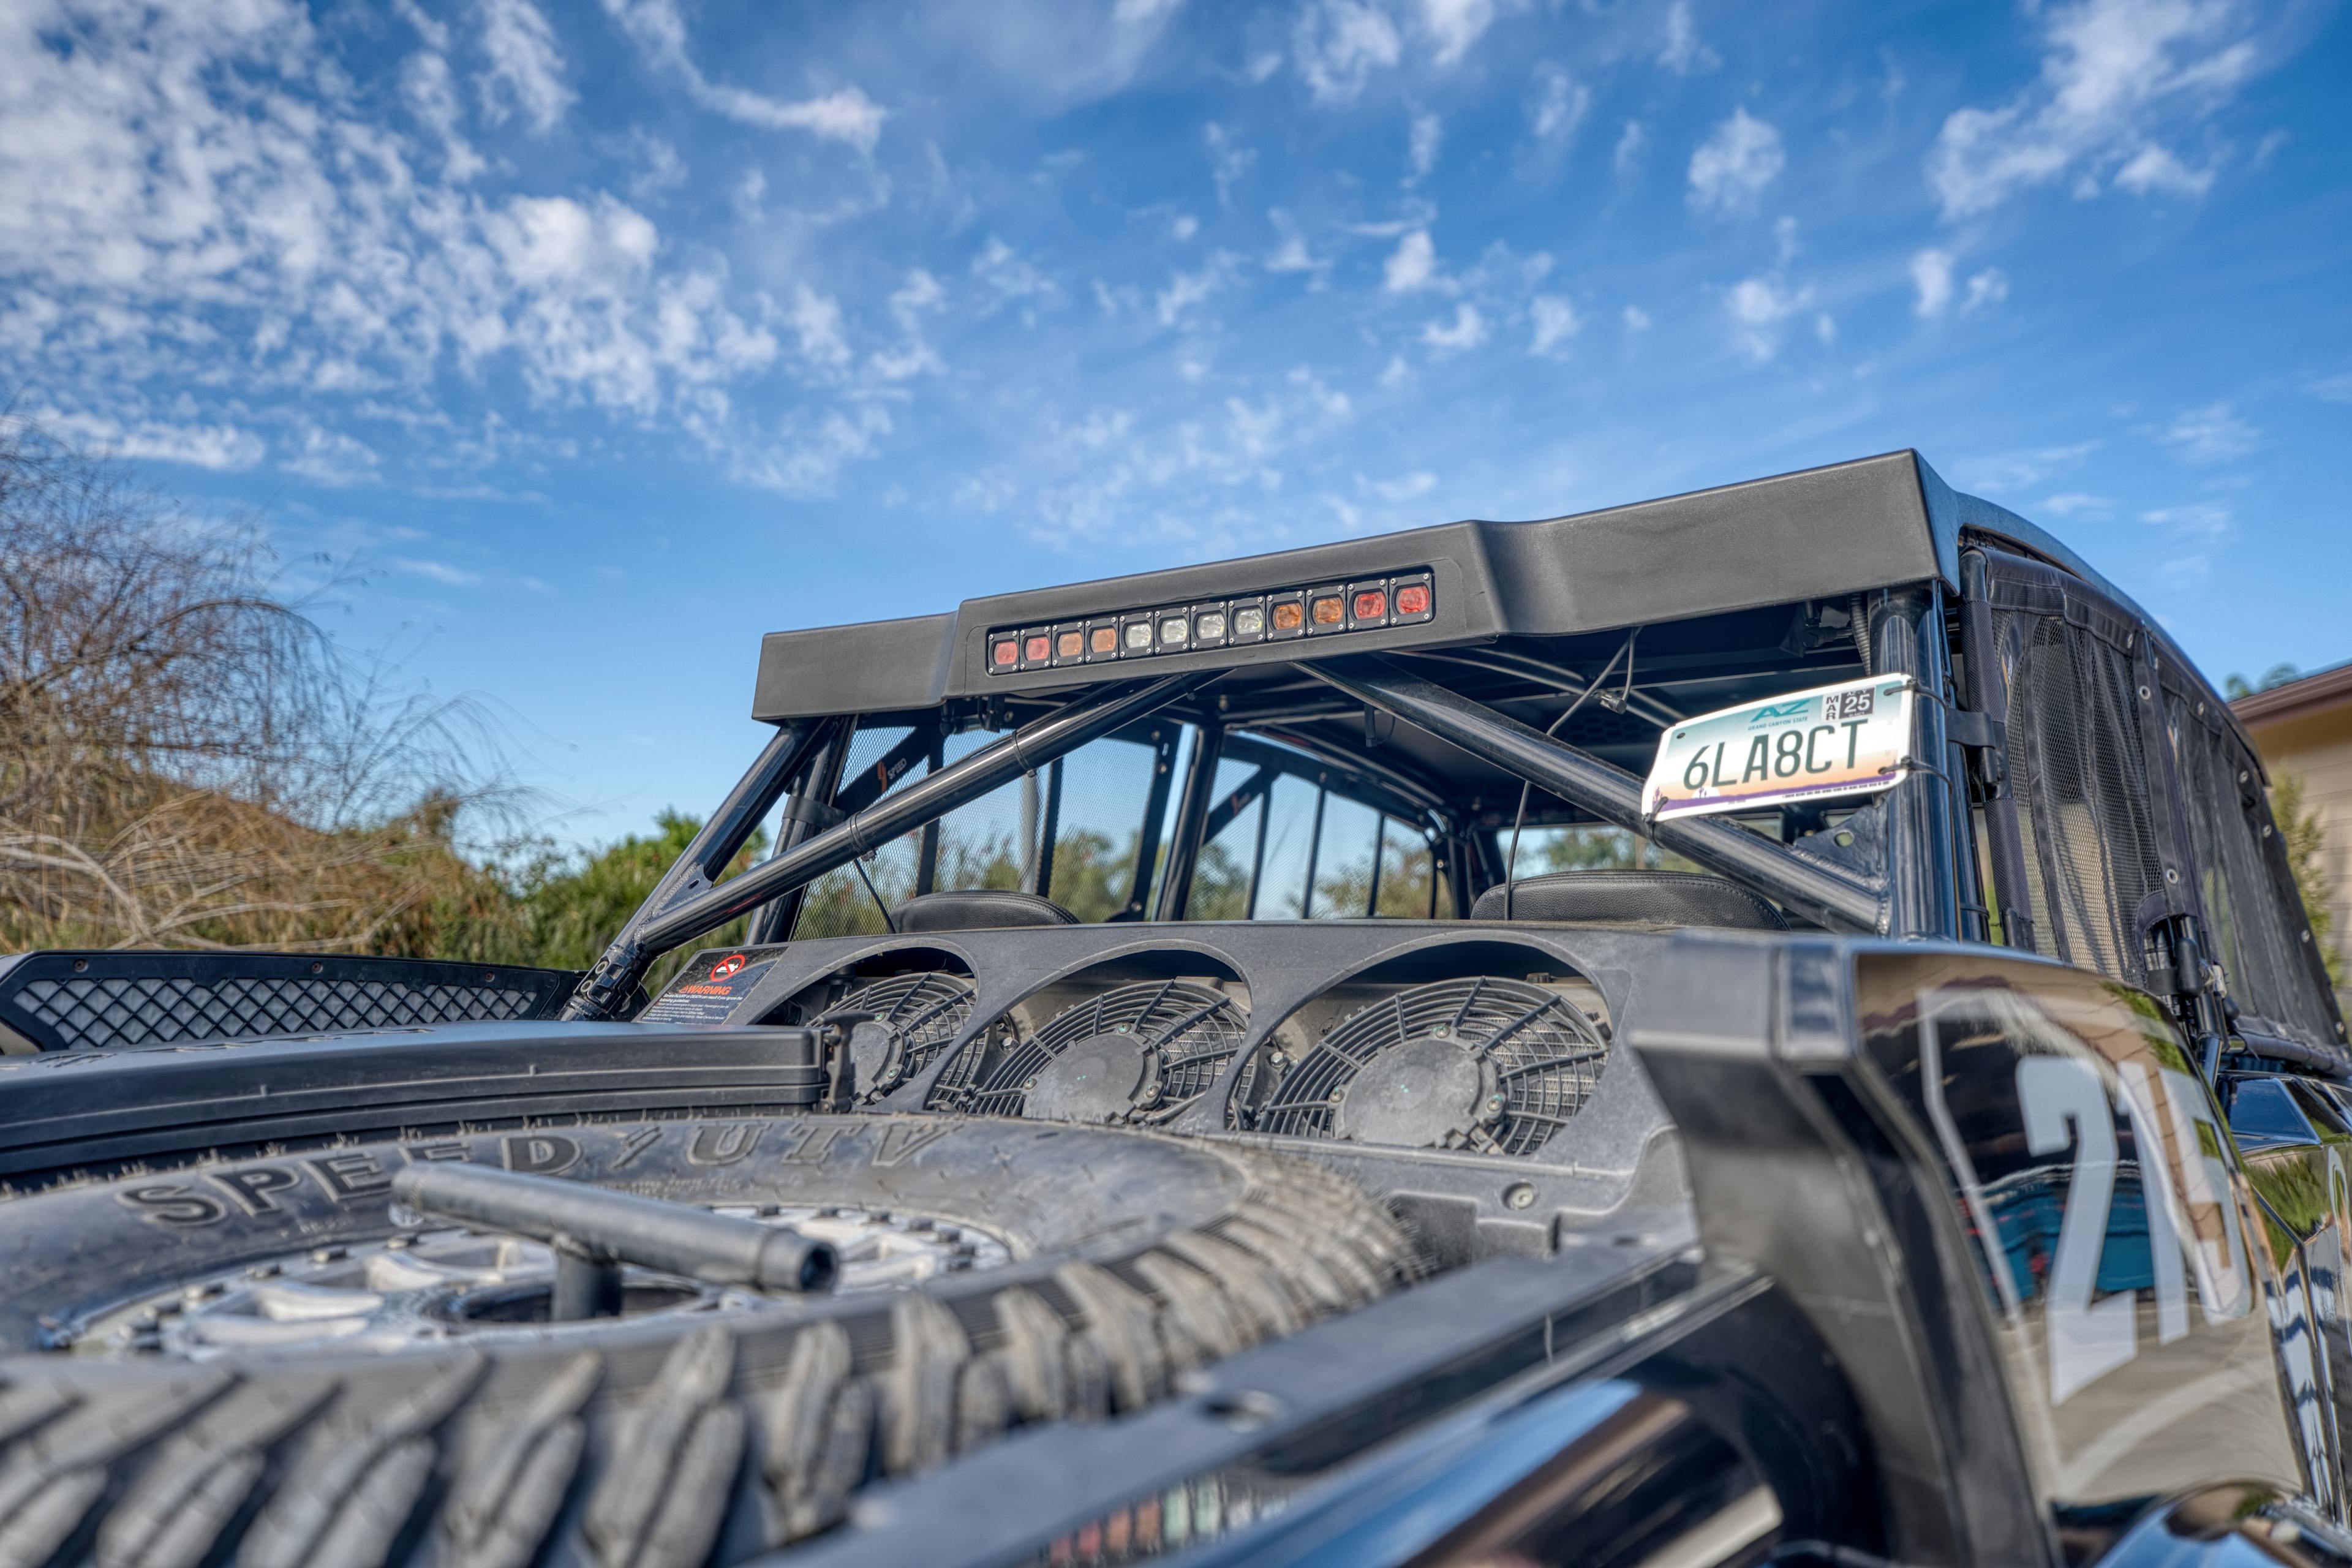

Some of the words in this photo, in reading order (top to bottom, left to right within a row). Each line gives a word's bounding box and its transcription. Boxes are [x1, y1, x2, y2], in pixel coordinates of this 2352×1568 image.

[1751, 699, 1811, 723] AZ
[1826, 695, 1839, 721] MAR
[1844, 693, 1871, 714] 25
[1768, 719, 1792, 728] CANYON
[1683, 718, 1869, 790] 6LA8CT
[688, 985, 733, 995] WARNING
[687, 1121, 965, 1166] UTV
